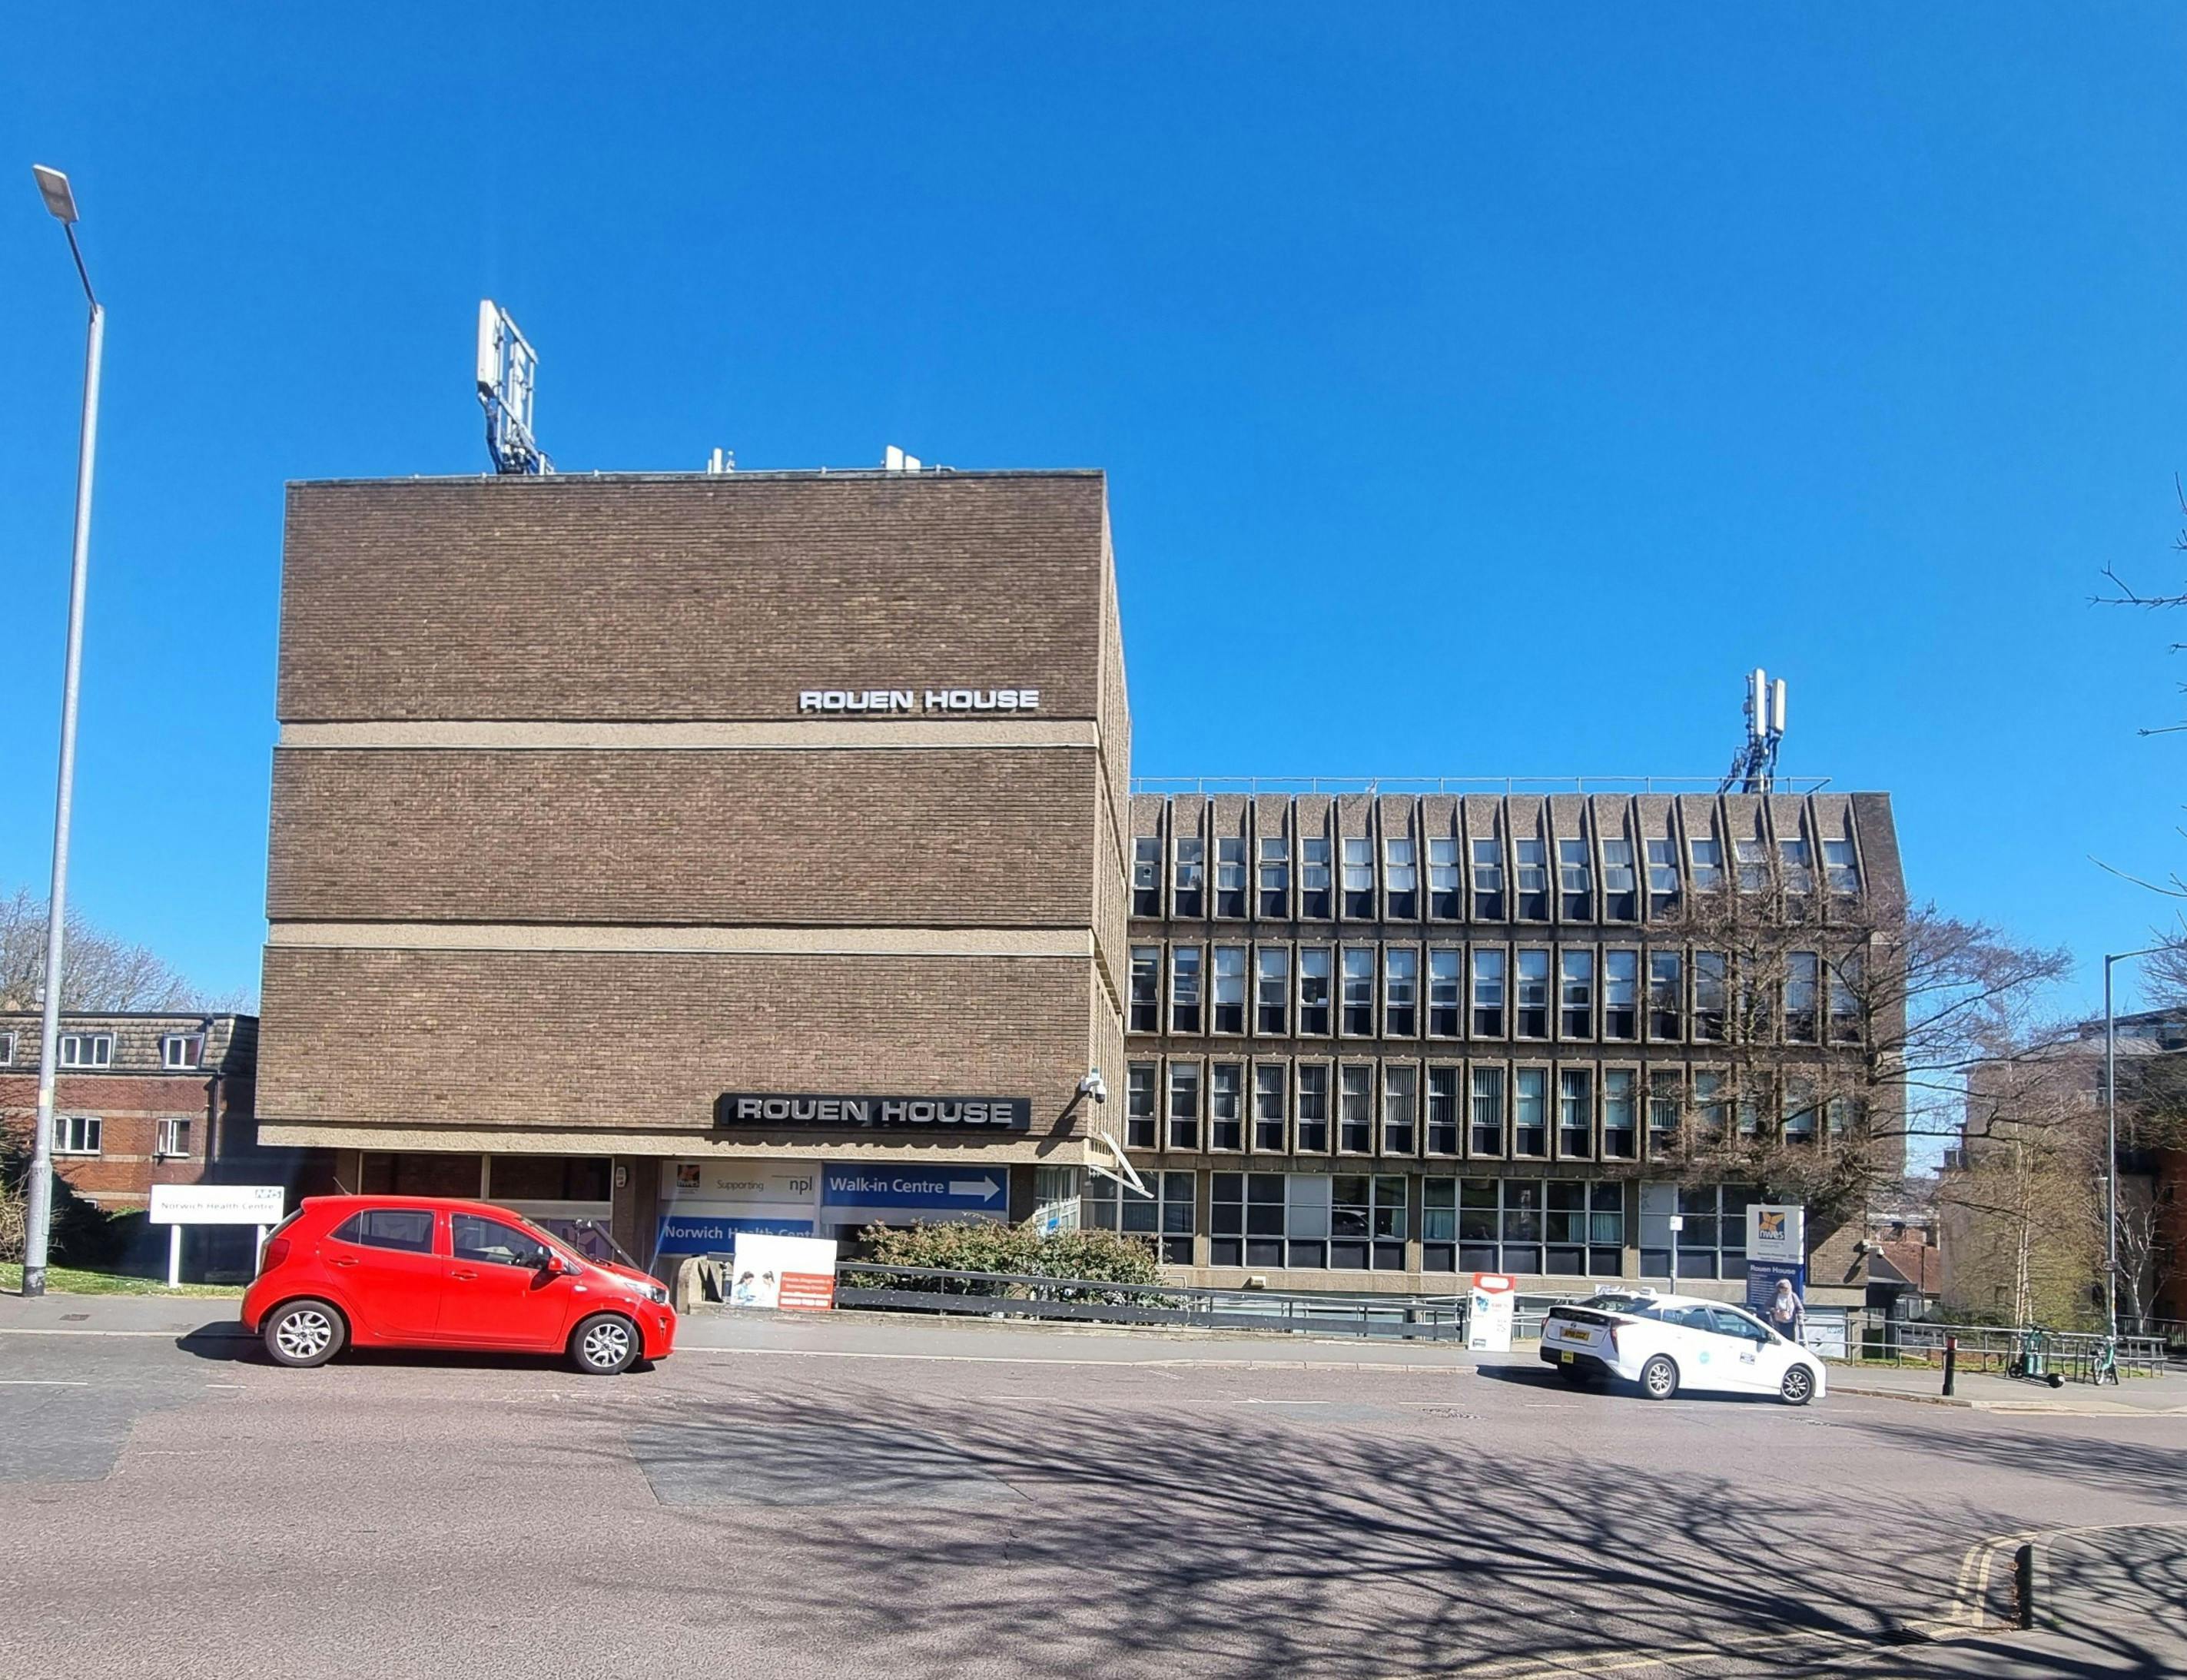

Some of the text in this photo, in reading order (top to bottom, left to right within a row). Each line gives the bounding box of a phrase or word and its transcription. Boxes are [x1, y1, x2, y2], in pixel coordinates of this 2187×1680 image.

[800, 690, 1039, 709] ROUEN HOUSE
[737, 1098, 1013, 1124] ROUEN HOUSE
[717, 1180, 765, 1191] Supporting
[790, 1175, 812, 1195] npl
[830, 1177, 944, 1194] Walk-in Centre
[665, 1225, 723, 1239] Norwich
[1760, 1230, 1784, 1239] nwes
[1773, 1267, 1796, 1275] House
